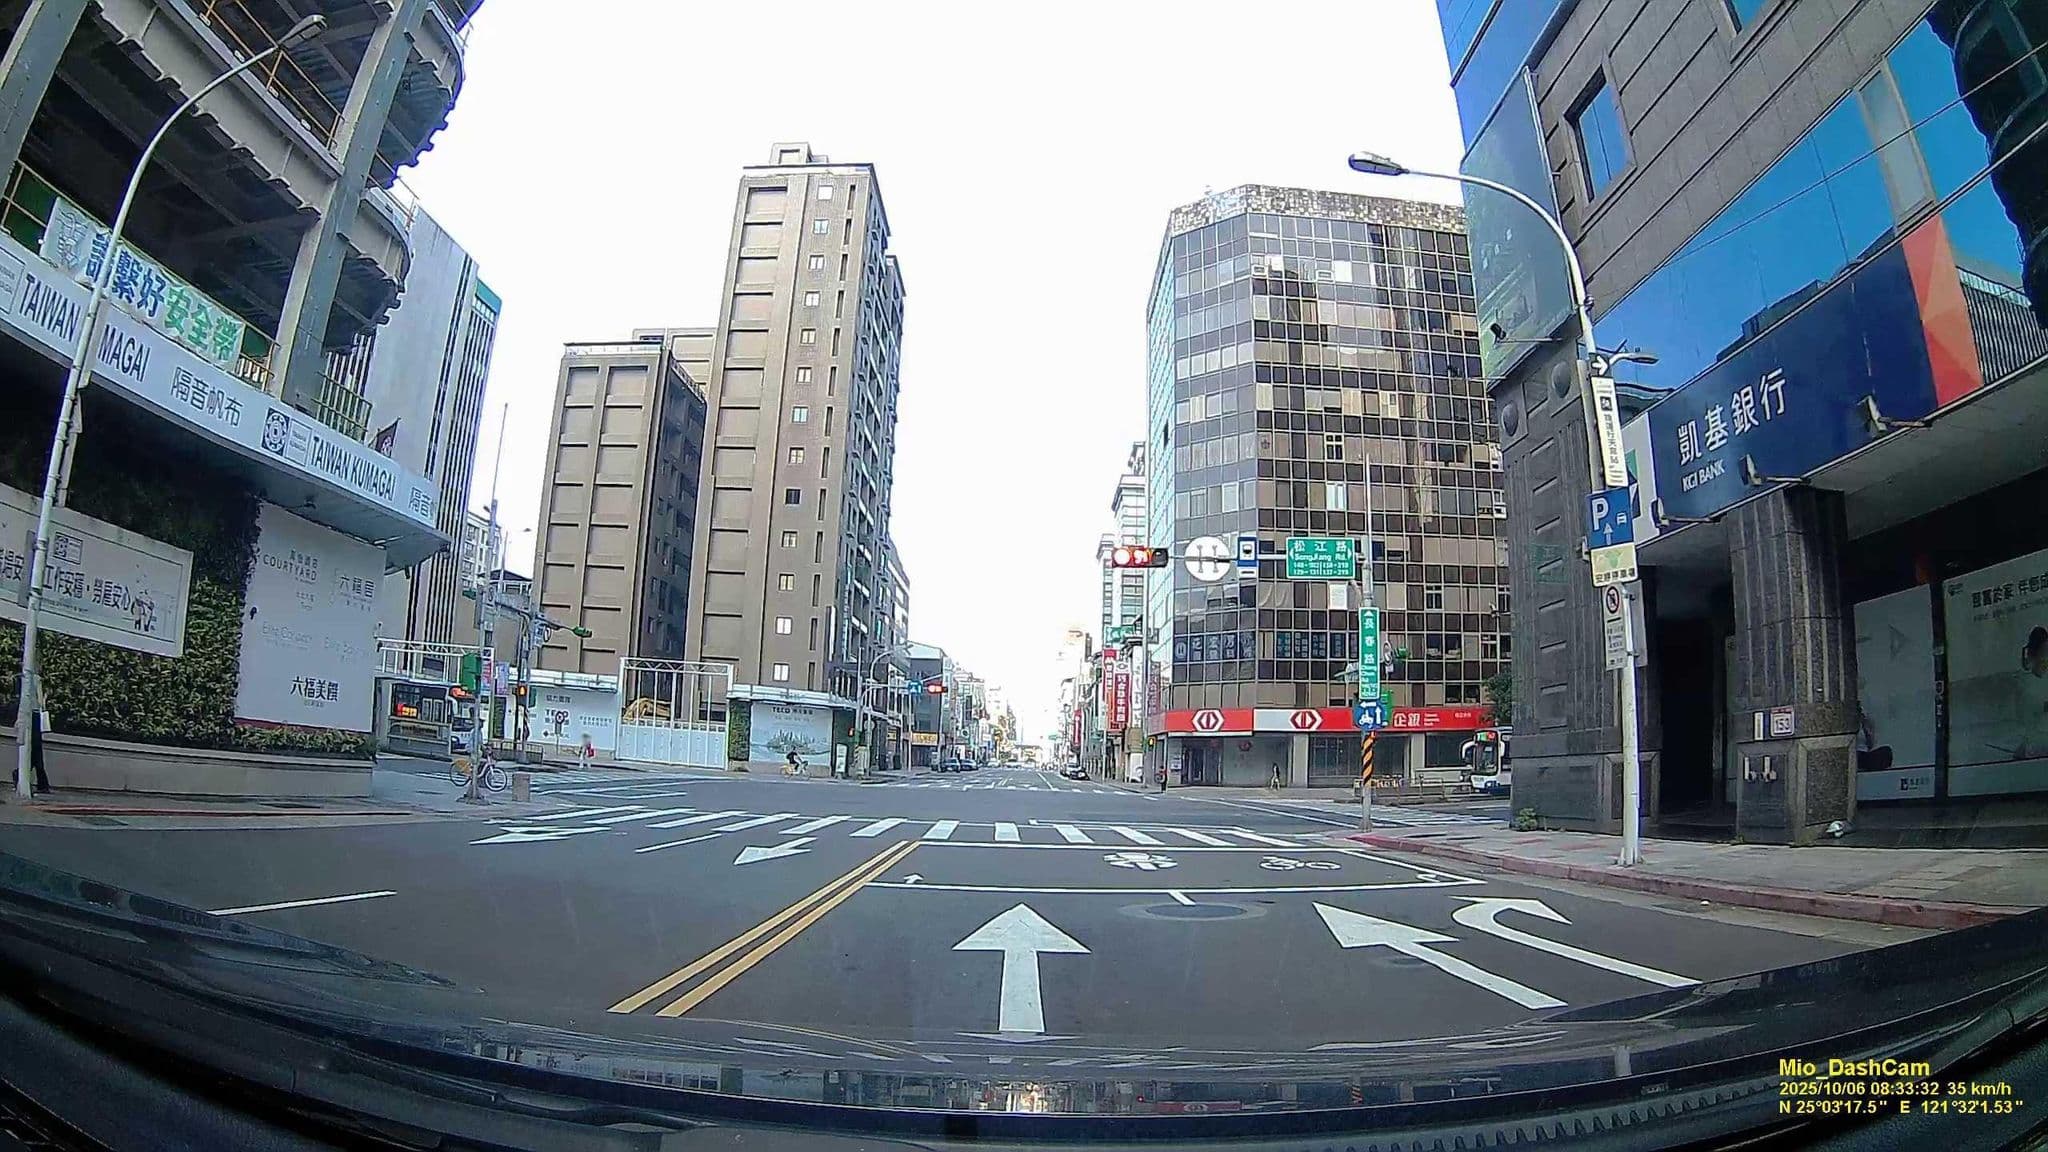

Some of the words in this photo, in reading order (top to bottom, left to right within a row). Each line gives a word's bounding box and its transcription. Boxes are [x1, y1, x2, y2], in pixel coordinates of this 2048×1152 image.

[18, 272, 82, 343] TAIWAN
[97, 324, 152, 383] MAGAI
[170, 366, 244, 427] 隔音帆布
[1677, 366, 1787, 467] 凱基銀行
[310, 436, 350, 482] TAIWAN
[350, 453, 397, 502] KUMAGAI
[1681, 472, 1699, 493] KGI
[1698, 457, 1726, 482] BANK
[1591, 497, 1609, 531] P
[263, 553, 317, 581] COURTYARD
[1294, 540, 1348, 552] 松江路
[1363, 617, 1375, 665] 長春路
[546, 708, 569, 718] TEO
